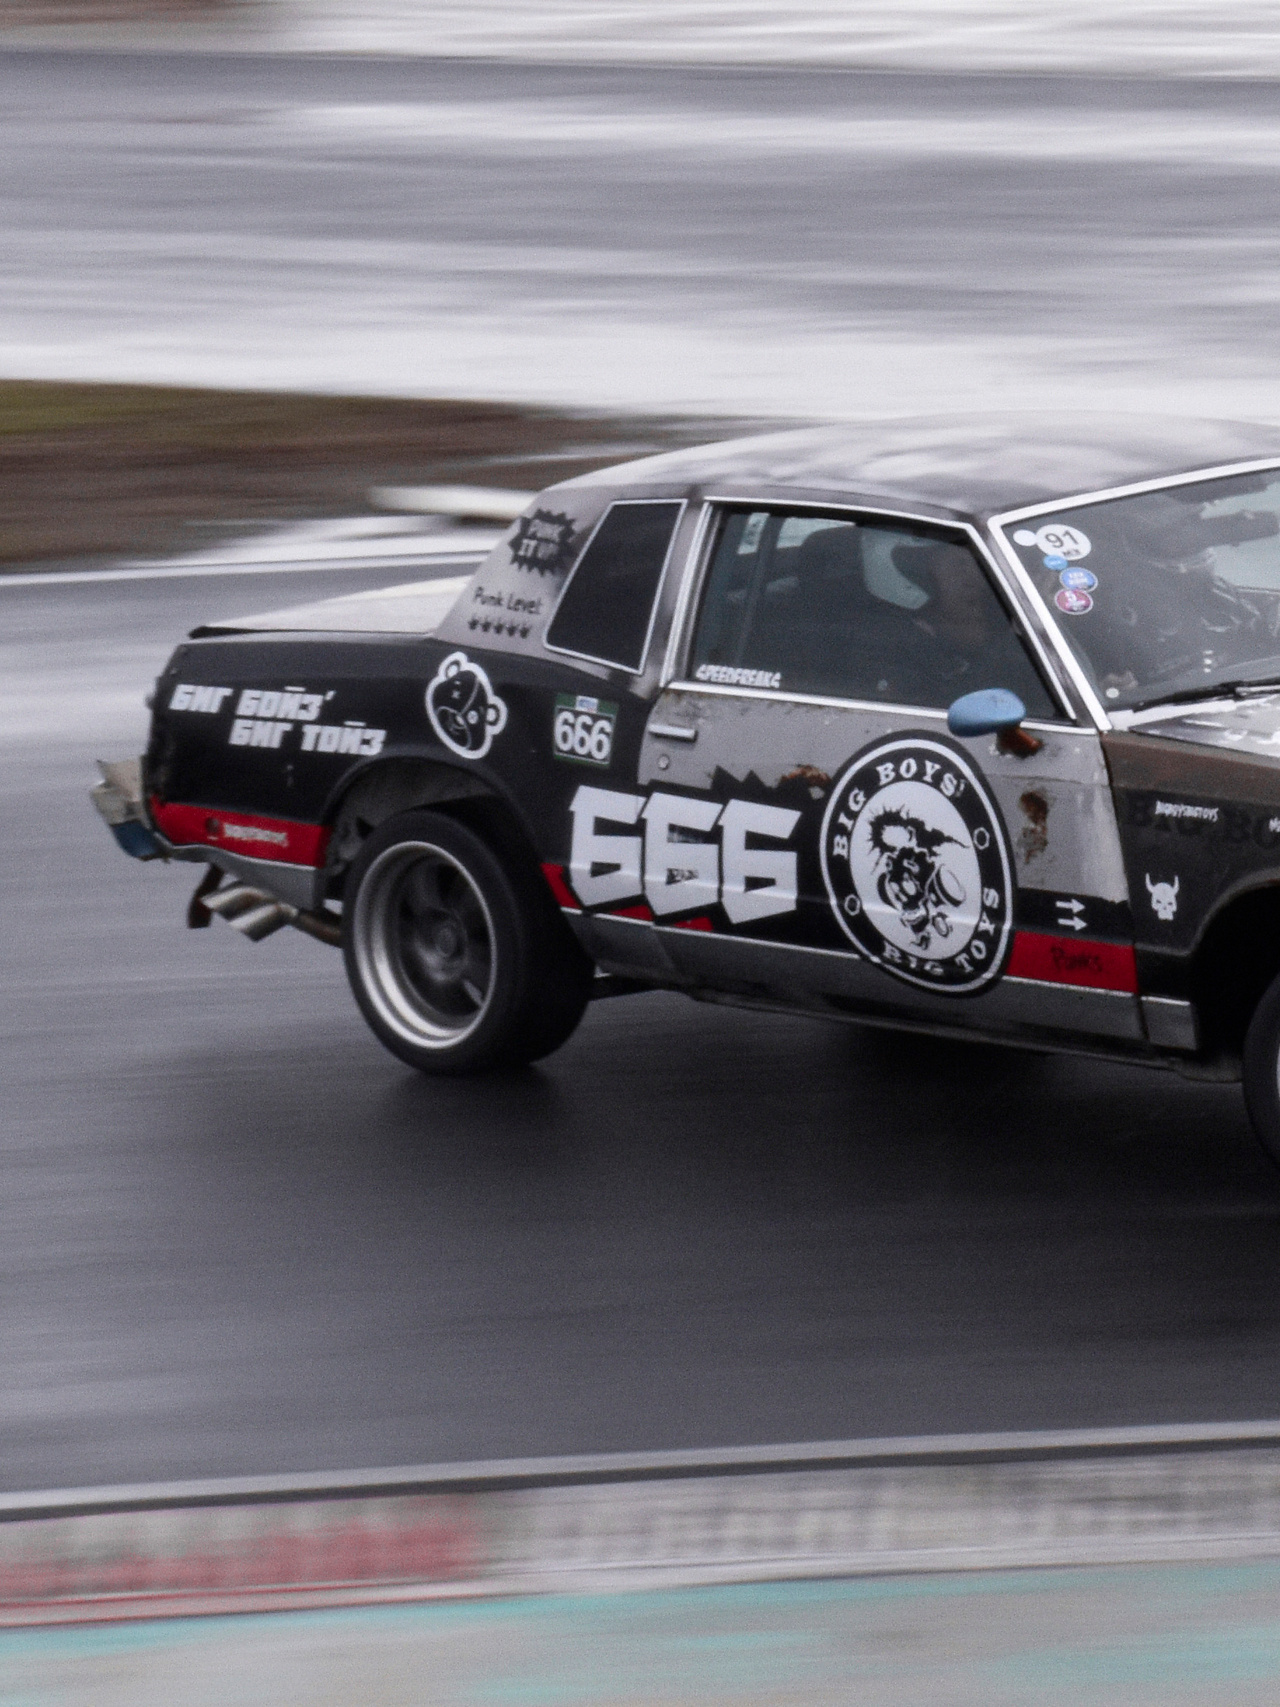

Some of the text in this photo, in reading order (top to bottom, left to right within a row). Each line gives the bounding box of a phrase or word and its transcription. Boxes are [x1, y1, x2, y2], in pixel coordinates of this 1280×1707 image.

[1044, 529, 1079, 549] 91
[554, 710, 612, 761] 666
[569, 784, 802, 925] 666
[832, 787, 867, 860] BIG
[954, 886, 1000, 973] TOYS
